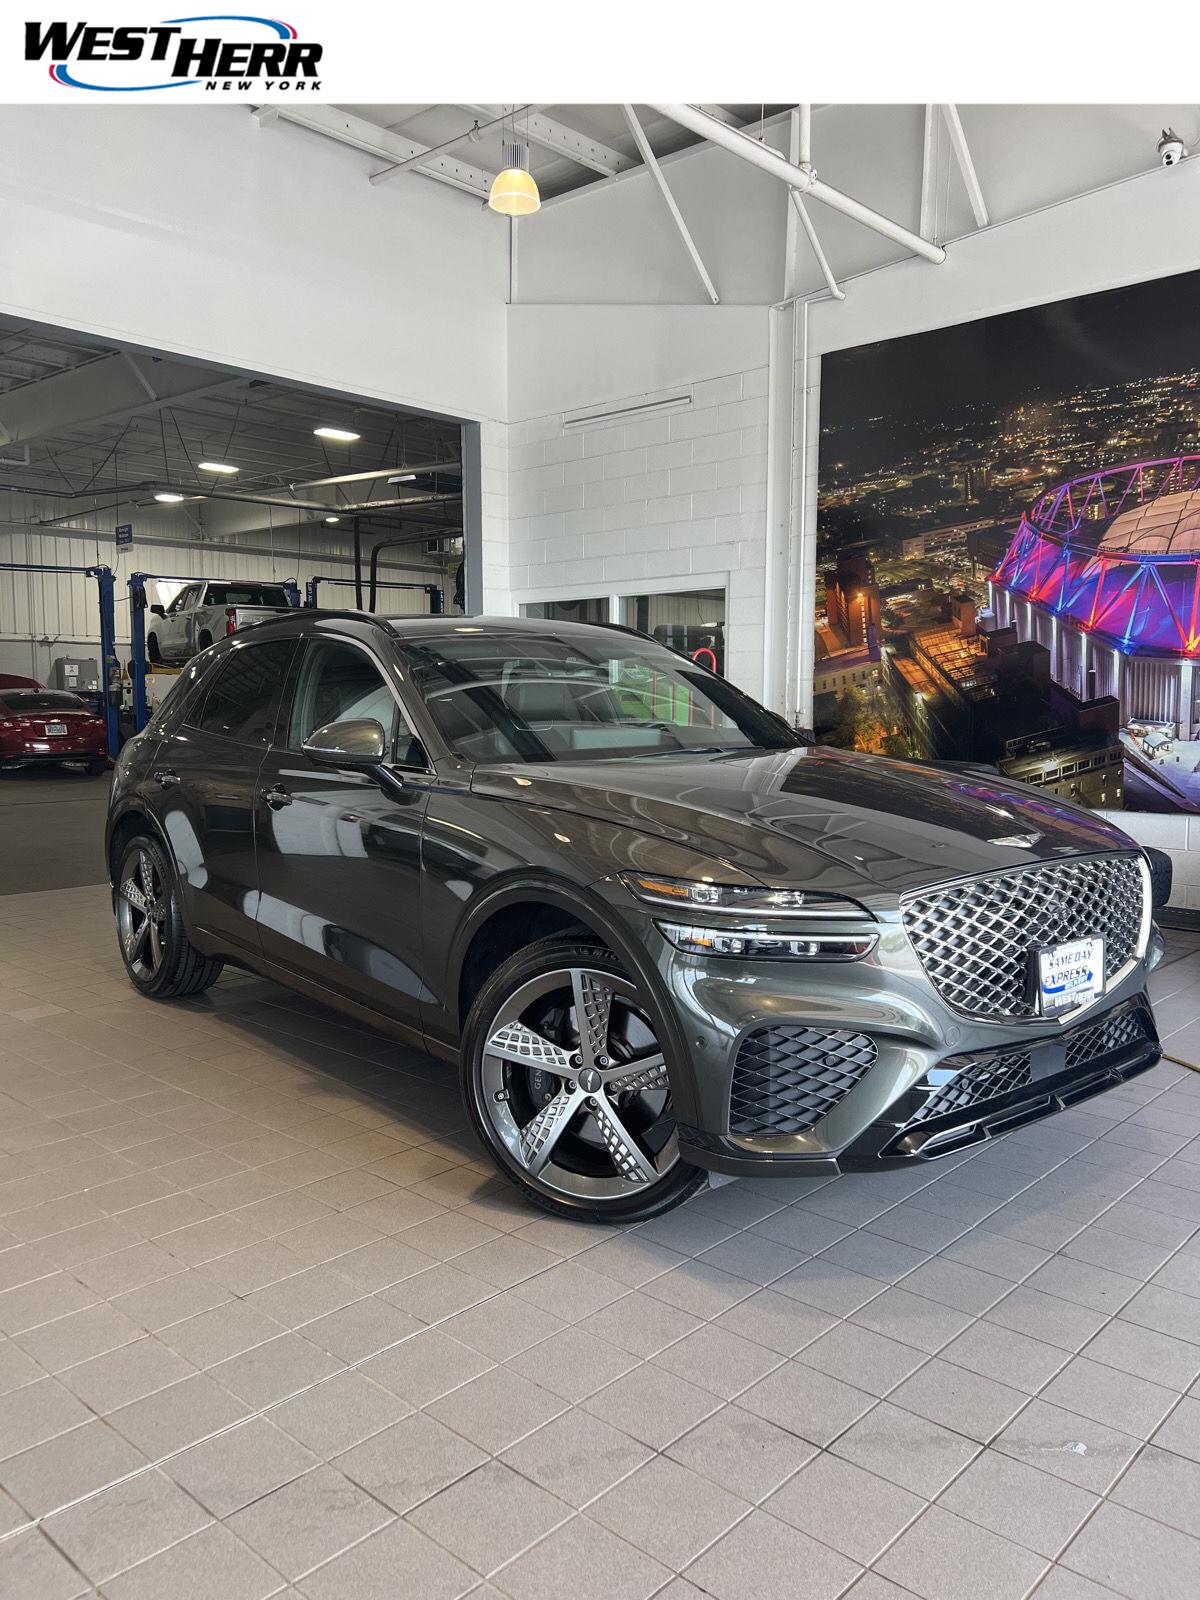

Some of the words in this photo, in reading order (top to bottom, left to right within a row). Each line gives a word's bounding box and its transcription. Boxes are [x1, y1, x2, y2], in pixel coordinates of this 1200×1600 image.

[1048, 953, 1074, 969] SAME
[1074, 949, 1094, 962] DAY
[1044, 965, 1089, 985] EXPRESS
